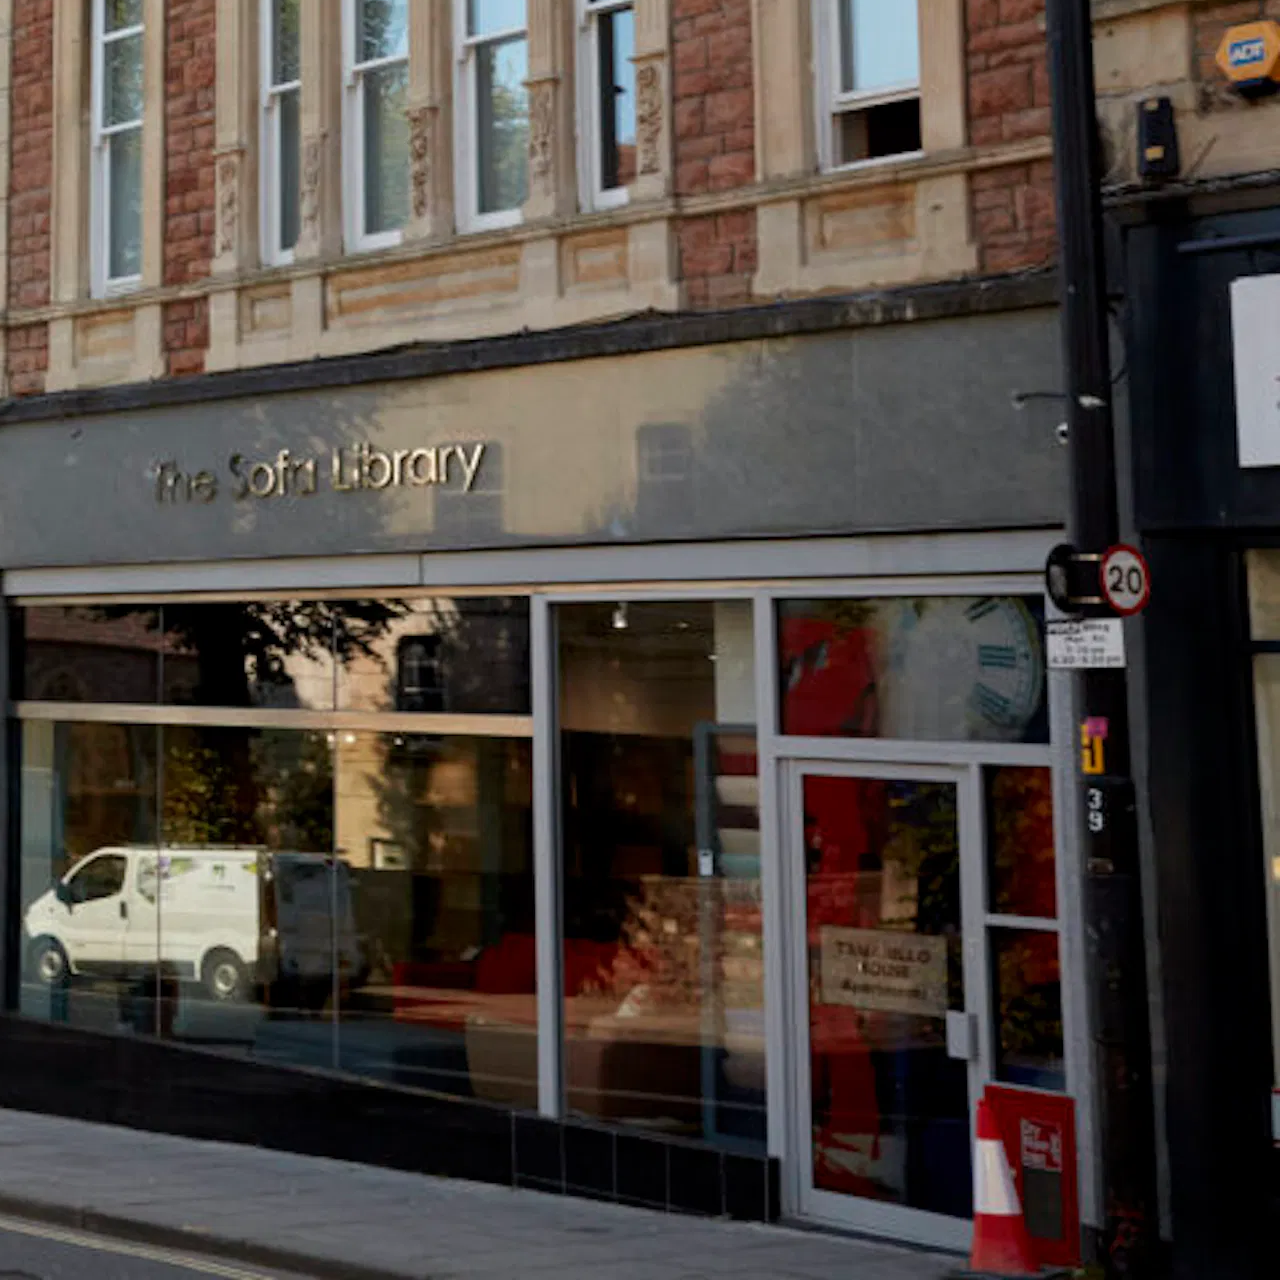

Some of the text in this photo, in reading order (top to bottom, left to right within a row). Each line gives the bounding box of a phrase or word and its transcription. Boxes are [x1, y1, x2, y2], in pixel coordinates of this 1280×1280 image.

[155, 442, 485, 504] The Sofa Library
[1109, 565, 1142, 594] 20
